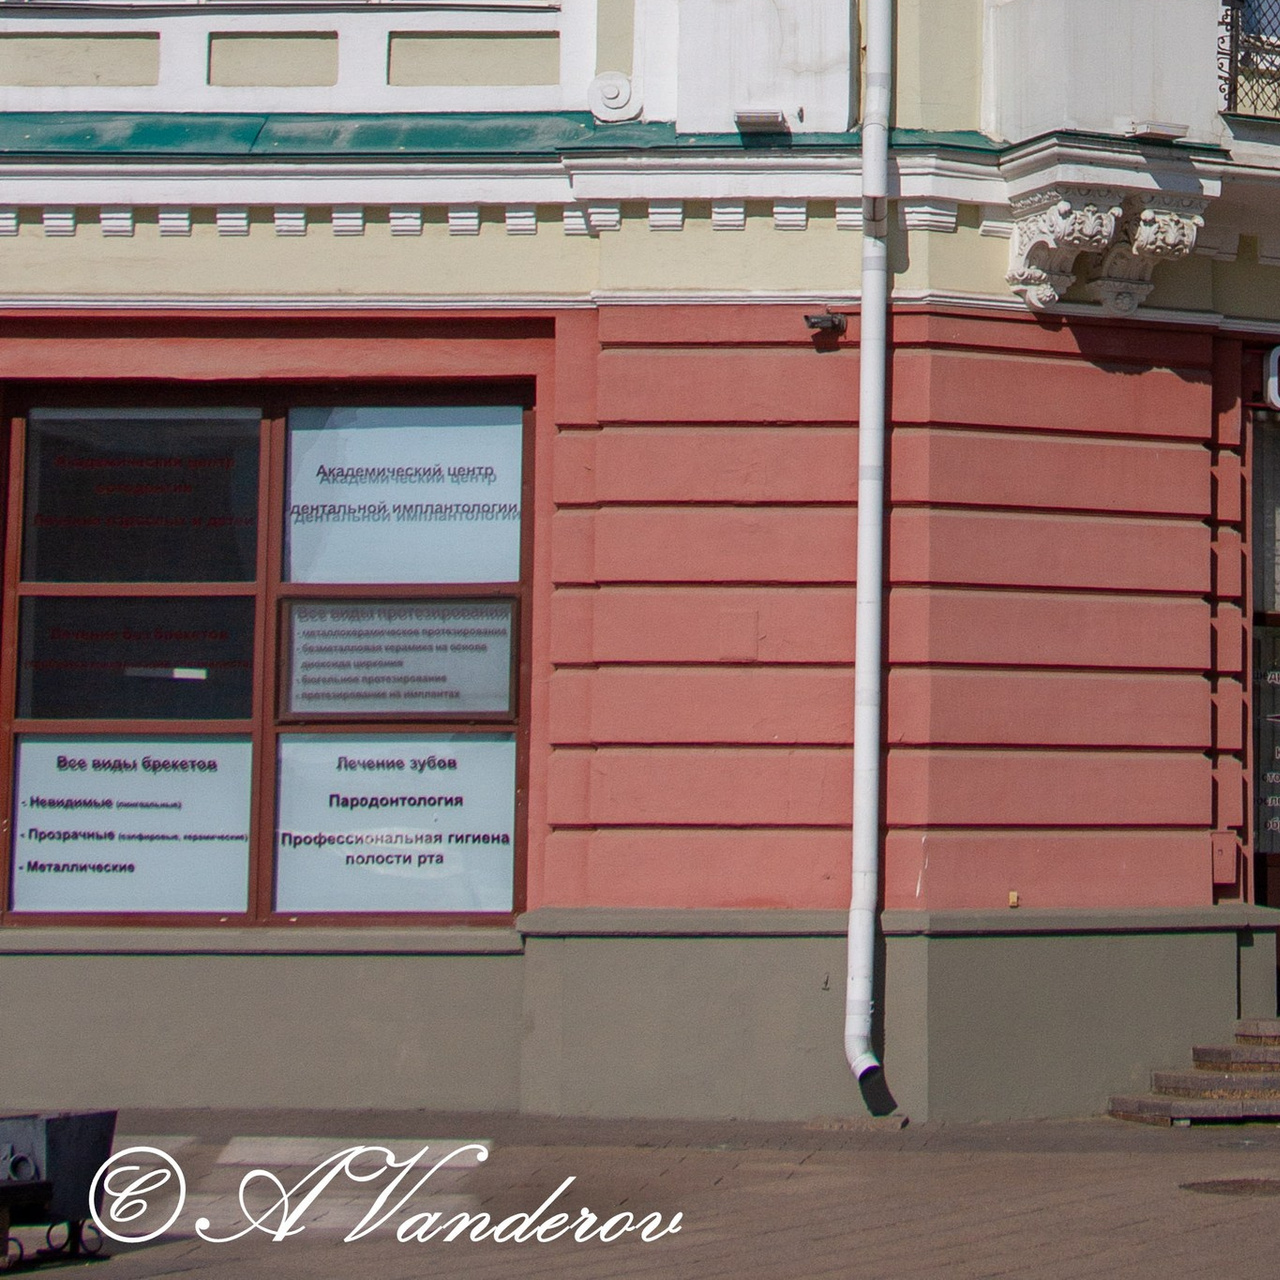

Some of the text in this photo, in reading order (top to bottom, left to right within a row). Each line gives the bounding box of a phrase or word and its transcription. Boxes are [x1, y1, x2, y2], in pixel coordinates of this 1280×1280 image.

[316, 463, 494, 479] Академический центр
[290, 500, 518, 516] дентальной имплантологии
[57, 755, 218, 773] Все виды брекетов
[336, 755, 457, 774] Лечение зубов
[29, 796, 113, 809] Невидимые
[329, 793, 464, 810] Пародонтология
[28, 827, 115, 842] Прозрачные
[281, 831, 510, 848] Профессиональная гигиена
[27, 860, 135, 873] Металлические
[345, 852, 444, 868] полости рта
